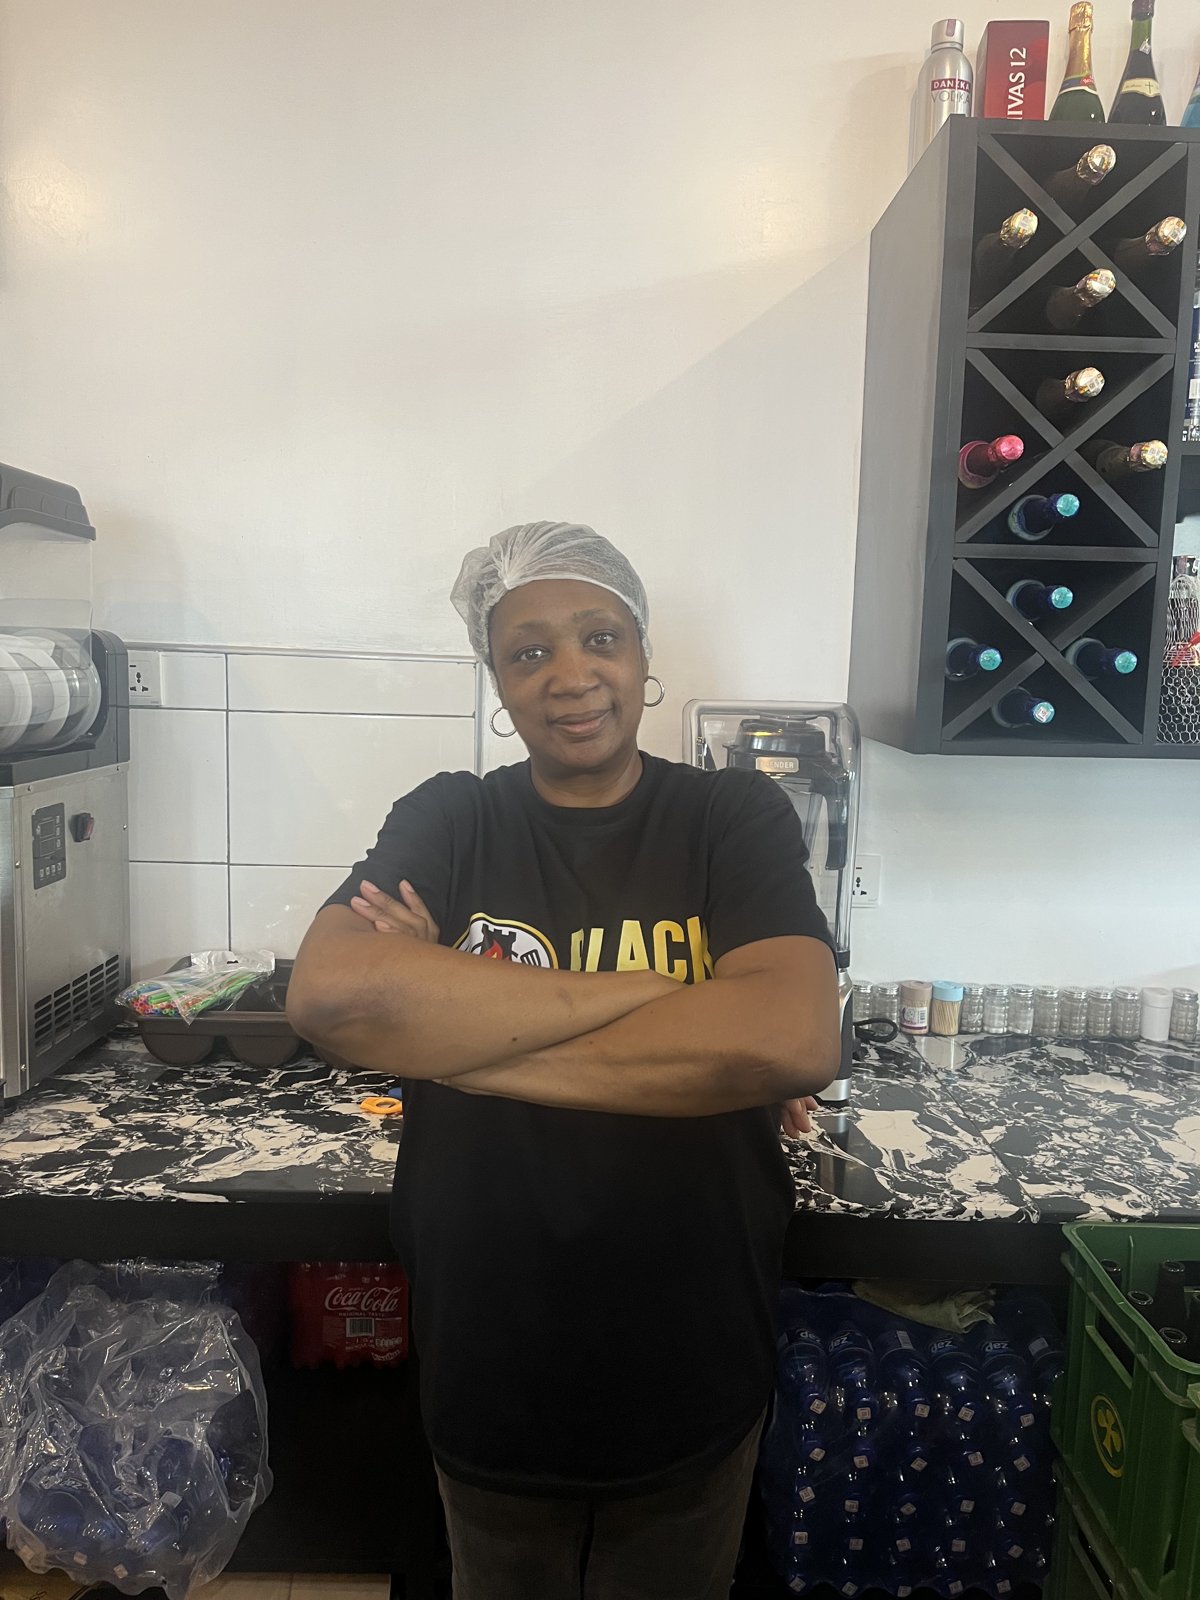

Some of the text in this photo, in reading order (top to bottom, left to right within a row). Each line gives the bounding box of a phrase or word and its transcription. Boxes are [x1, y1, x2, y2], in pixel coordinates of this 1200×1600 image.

[933, 80, 970, 90] DANZKA
[1007, 47, 1027, 120] IVAS 12
[931, 91, 970, 104] VODKA
[324, 1286, 402, 1312] Coca-Cola
